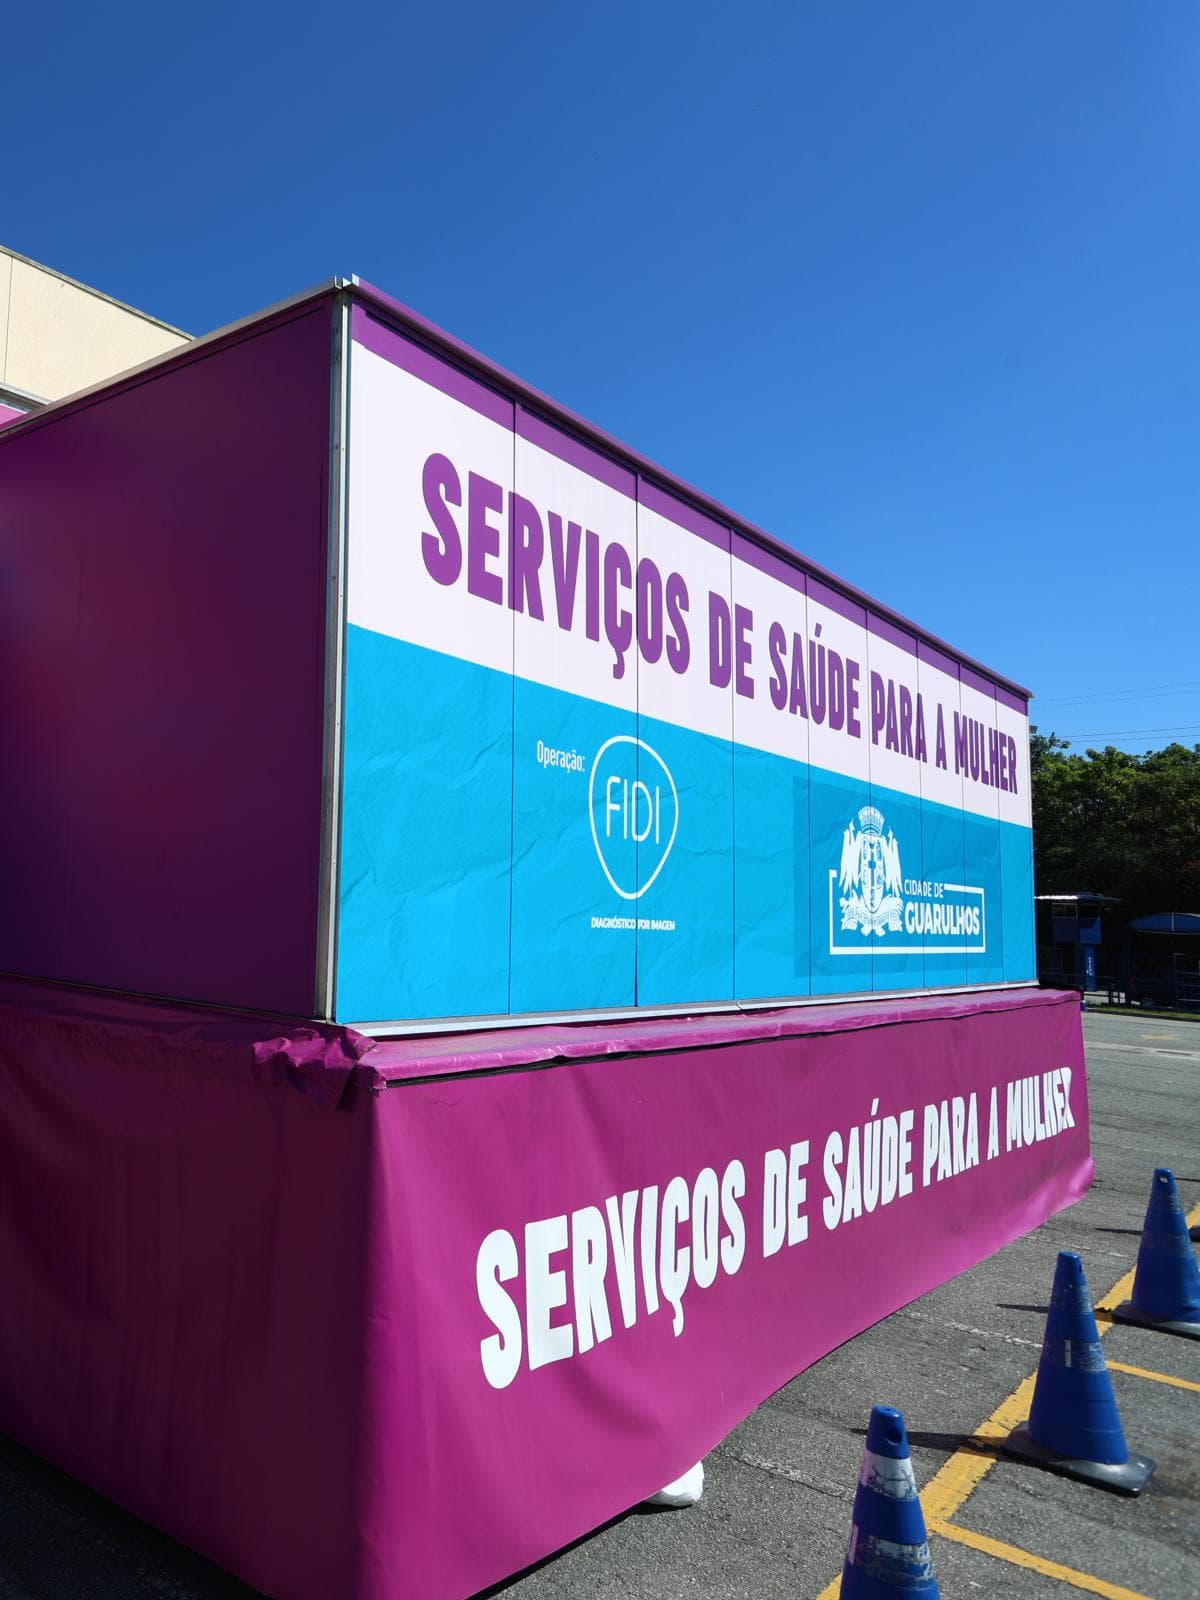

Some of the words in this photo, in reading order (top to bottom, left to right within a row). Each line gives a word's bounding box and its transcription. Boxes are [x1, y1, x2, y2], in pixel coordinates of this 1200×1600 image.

[421, 453, 690, 680] SERVIÇOS
[708, 590, 755, 700] DE
[768, 620, 862, 739] SAÚDE
[870, 670, 928, 764] PARA
[935, 702, 948, 771] A
[953, 710, 1019, 796] MULHER
[537, 739, 586, 774] Operação:
[606, 775, 661, 845] FIDI
[904, 878, 933, 898] CIDADE
[933, 882, 945, 899] DE
[591, 915, 637, 930] DIAGNÓSTICO
[637, 918, 650, 931] POR
[650, 919, 676, 931] IMAGEM
[904, 901, 981, 936] GUARULHOS
[476, 1159, 746, 1390] SERVIÇOS
[762, 1140, 810, 1259] DE
[822, 1097, 914, 1231] SAÚDE
[922, 1092, 980, 1187] PARA
[987, 1086, 1000, 1161] A
